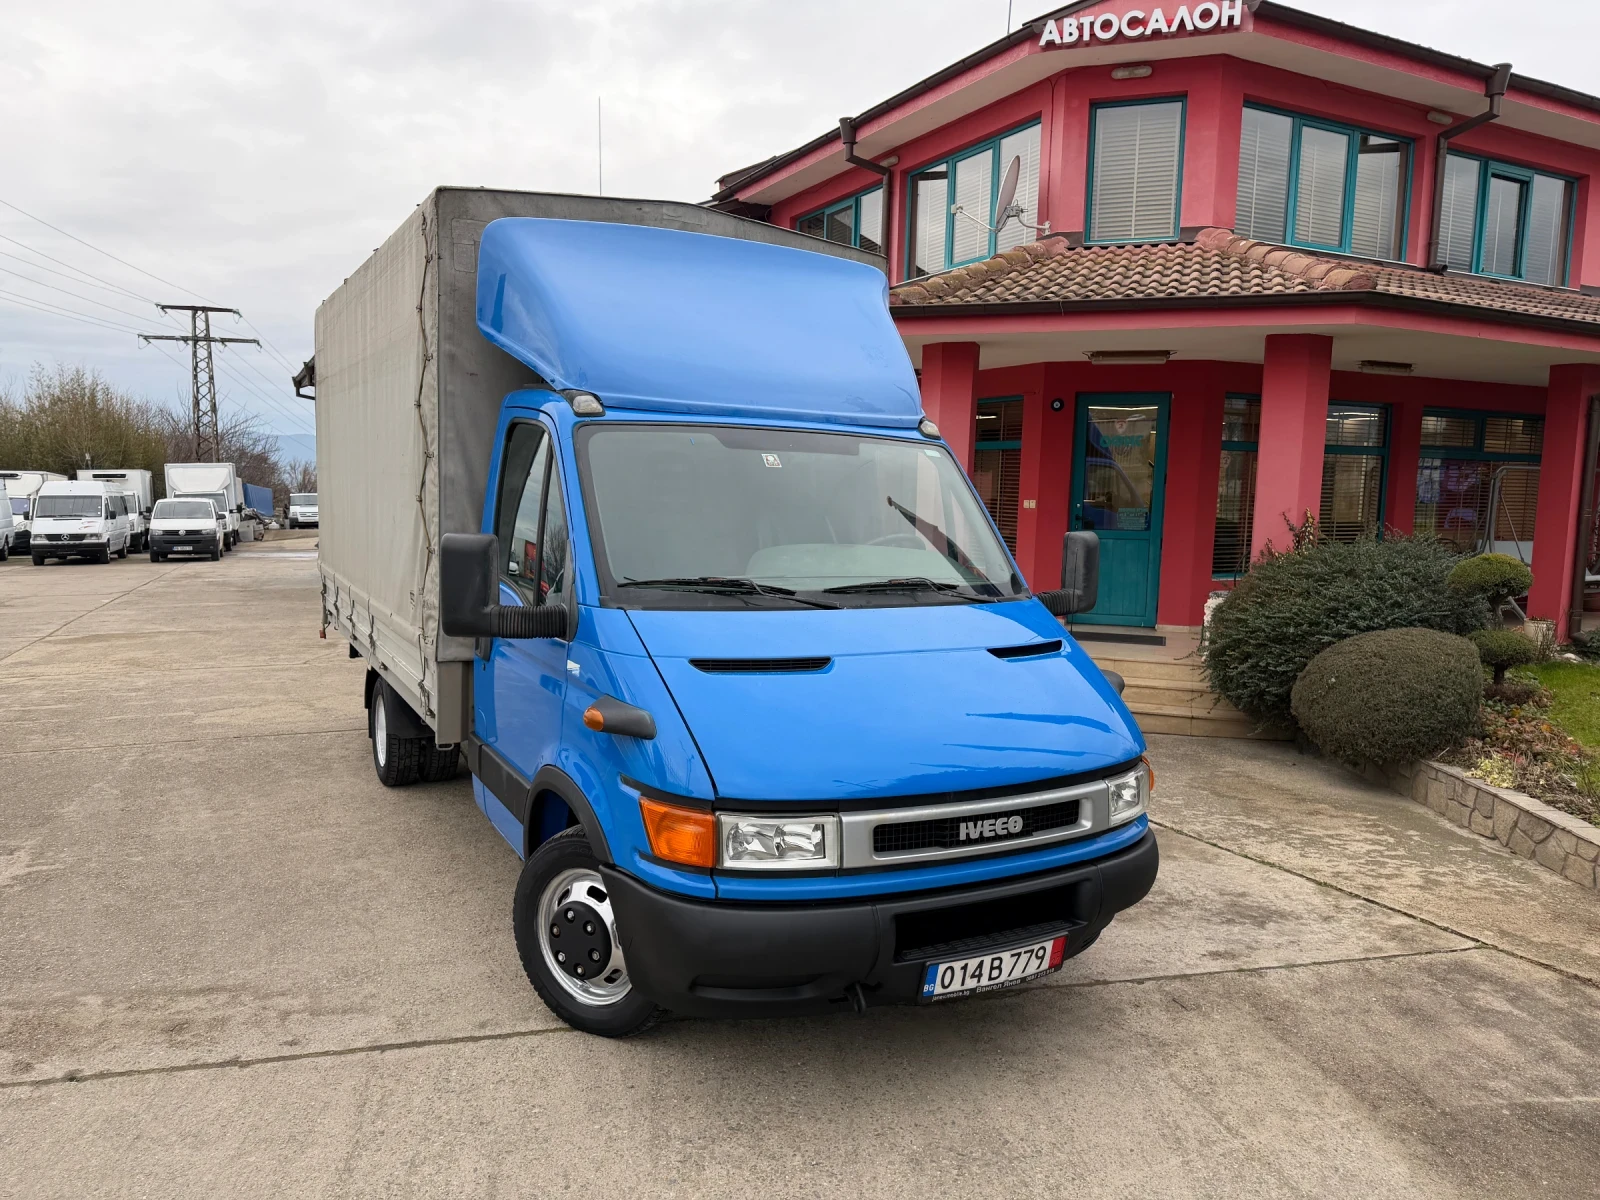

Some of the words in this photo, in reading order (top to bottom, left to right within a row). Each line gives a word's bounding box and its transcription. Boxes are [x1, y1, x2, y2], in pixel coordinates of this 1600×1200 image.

[1039, 0, 1242, 47] АВТОСАЛОН
[959, 815, 1023, 841] IVECO
[923, 983, 935, 993] BG
[940, 945, 1047, 989] 014B779
